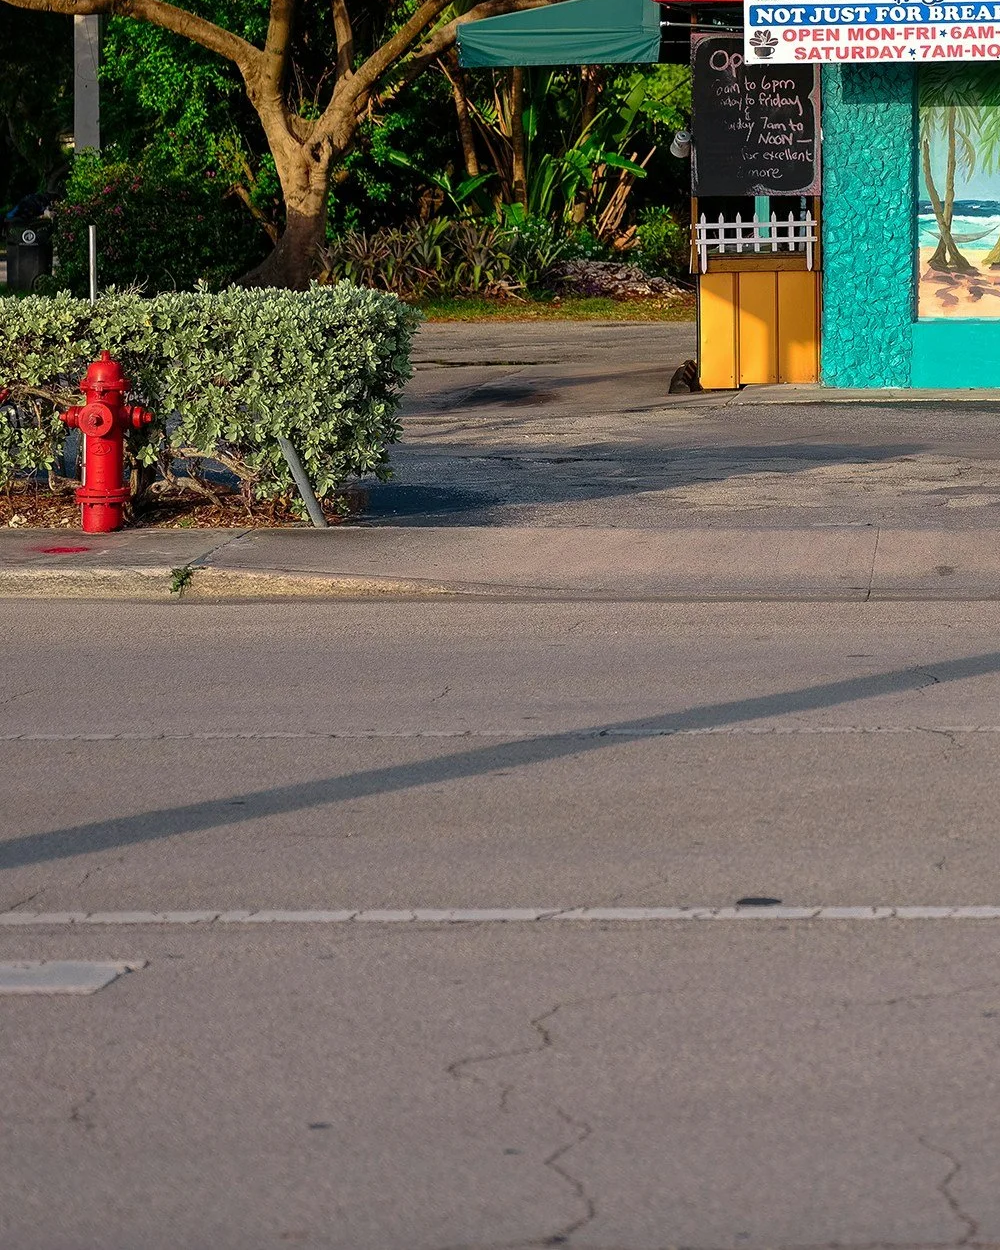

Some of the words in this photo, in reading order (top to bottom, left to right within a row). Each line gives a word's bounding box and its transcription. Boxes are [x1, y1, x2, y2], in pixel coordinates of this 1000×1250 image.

[756, 8, 806, 24] NOT
[809, 6, 871, 23] JUST
[875, 6, 924, 22] FOR
[782, 28, 840, 42] OPEN
[847, 26, 936, 41] MON-FRI
[794, 45, 907, 61] SATURDAY
[744, 76, 757, 91] to
[761, 75, 796, 93] 6pm
[745, 93, 755, 106] to
[760, 116, 787, 132] 7am
[788, 118, 804, 131] to
[763, 148, 814, 162] excellent
